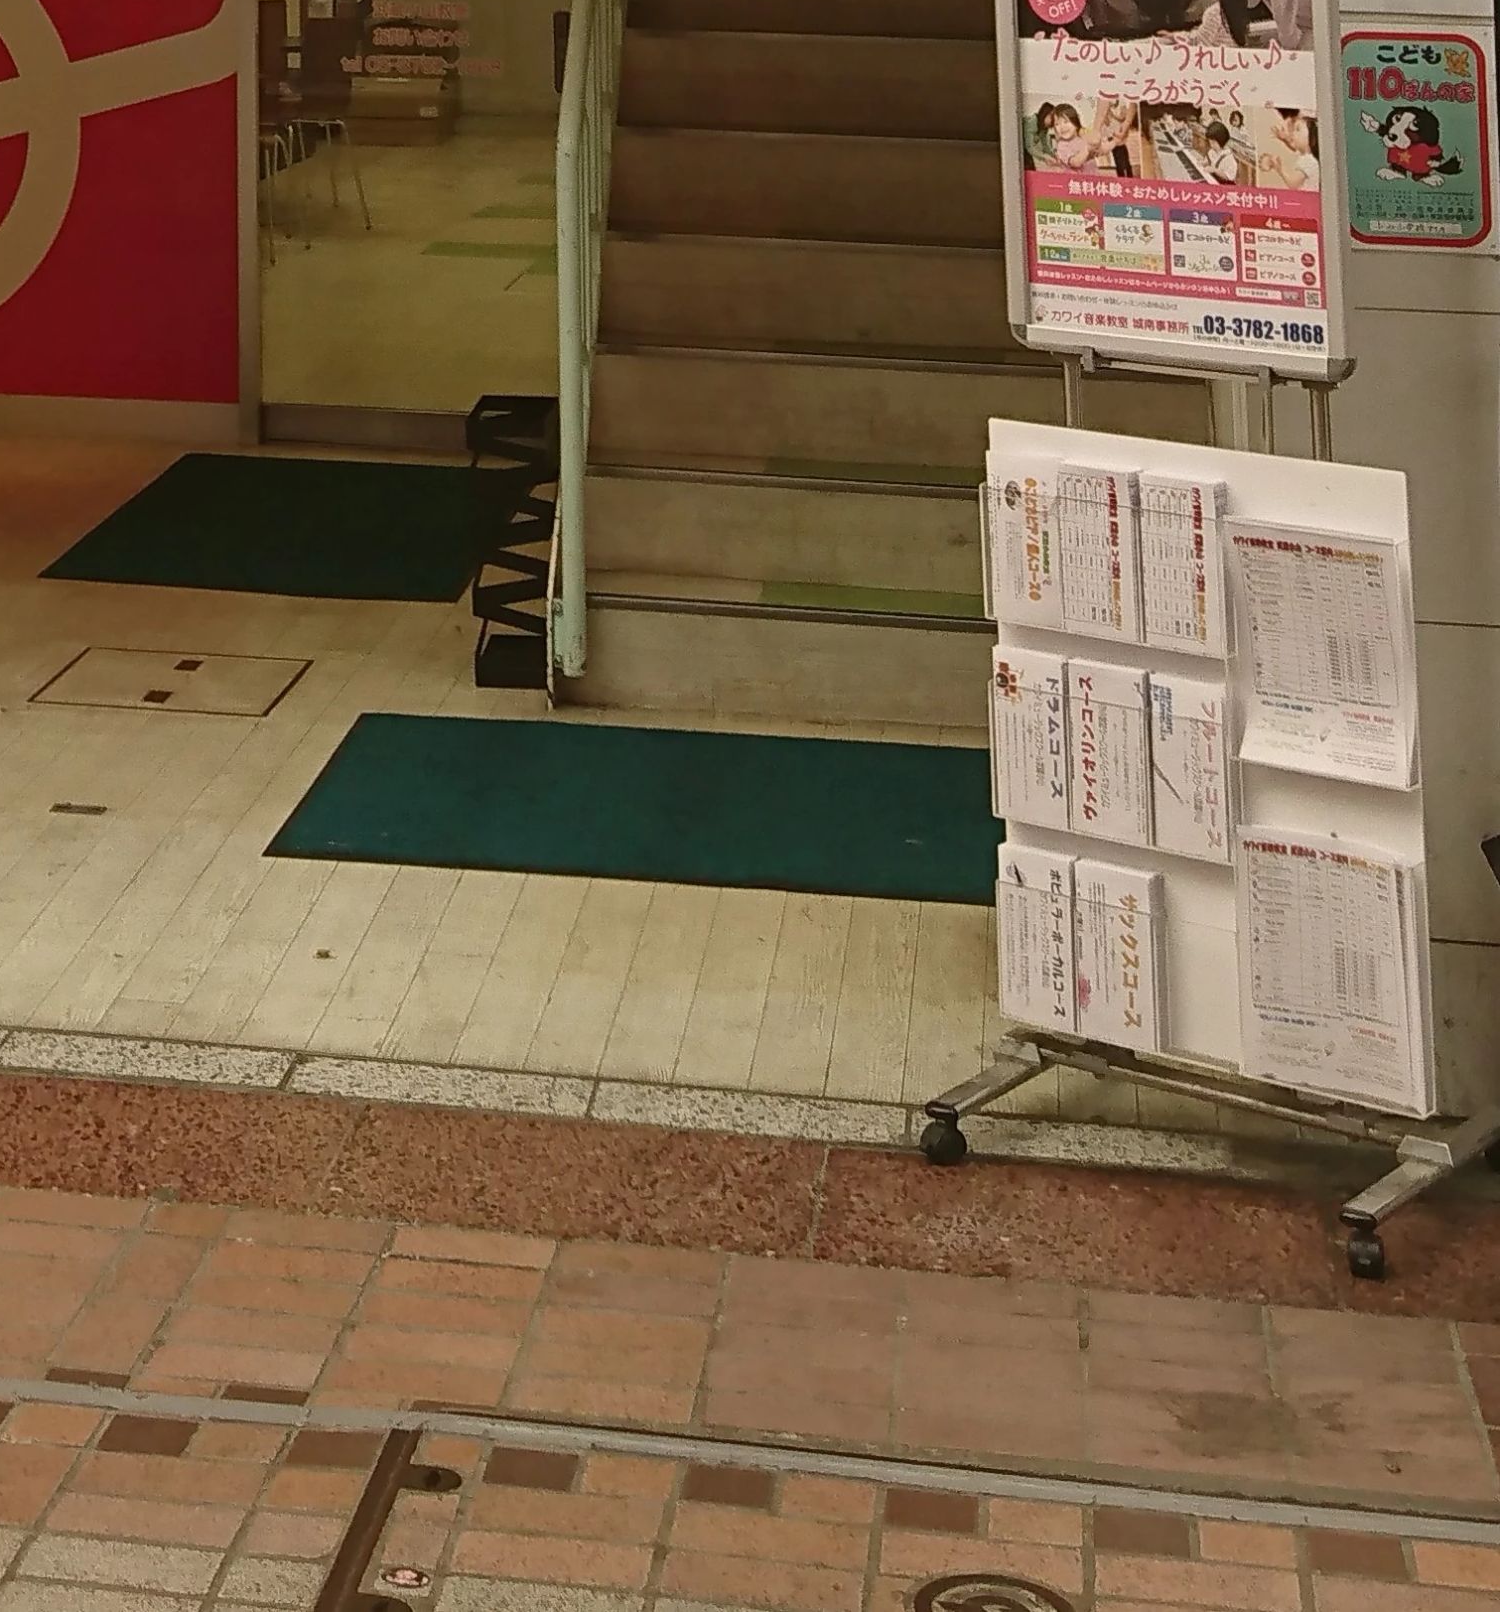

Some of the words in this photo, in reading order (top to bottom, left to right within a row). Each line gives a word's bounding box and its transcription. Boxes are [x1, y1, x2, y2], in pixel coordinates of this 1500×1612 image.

[1100, 73, 1242, 107] こころがうごく
[1347, 66, 1477, 103] 110ばんの家
[1376, 44, 1442, 65] こども
[1051, 309, 1129, 329] カワイ音楽教室
[1203, 315, 1325, 345] 03-3782-1868
[1045, 677, 1064, 799] ドラムコース
[1078, 676, 1098, 821] ヴァイオリンコース
[1201, 700, 1223, 849] フルートコース
[1118, 893, 1143, 1028] サックスコース
